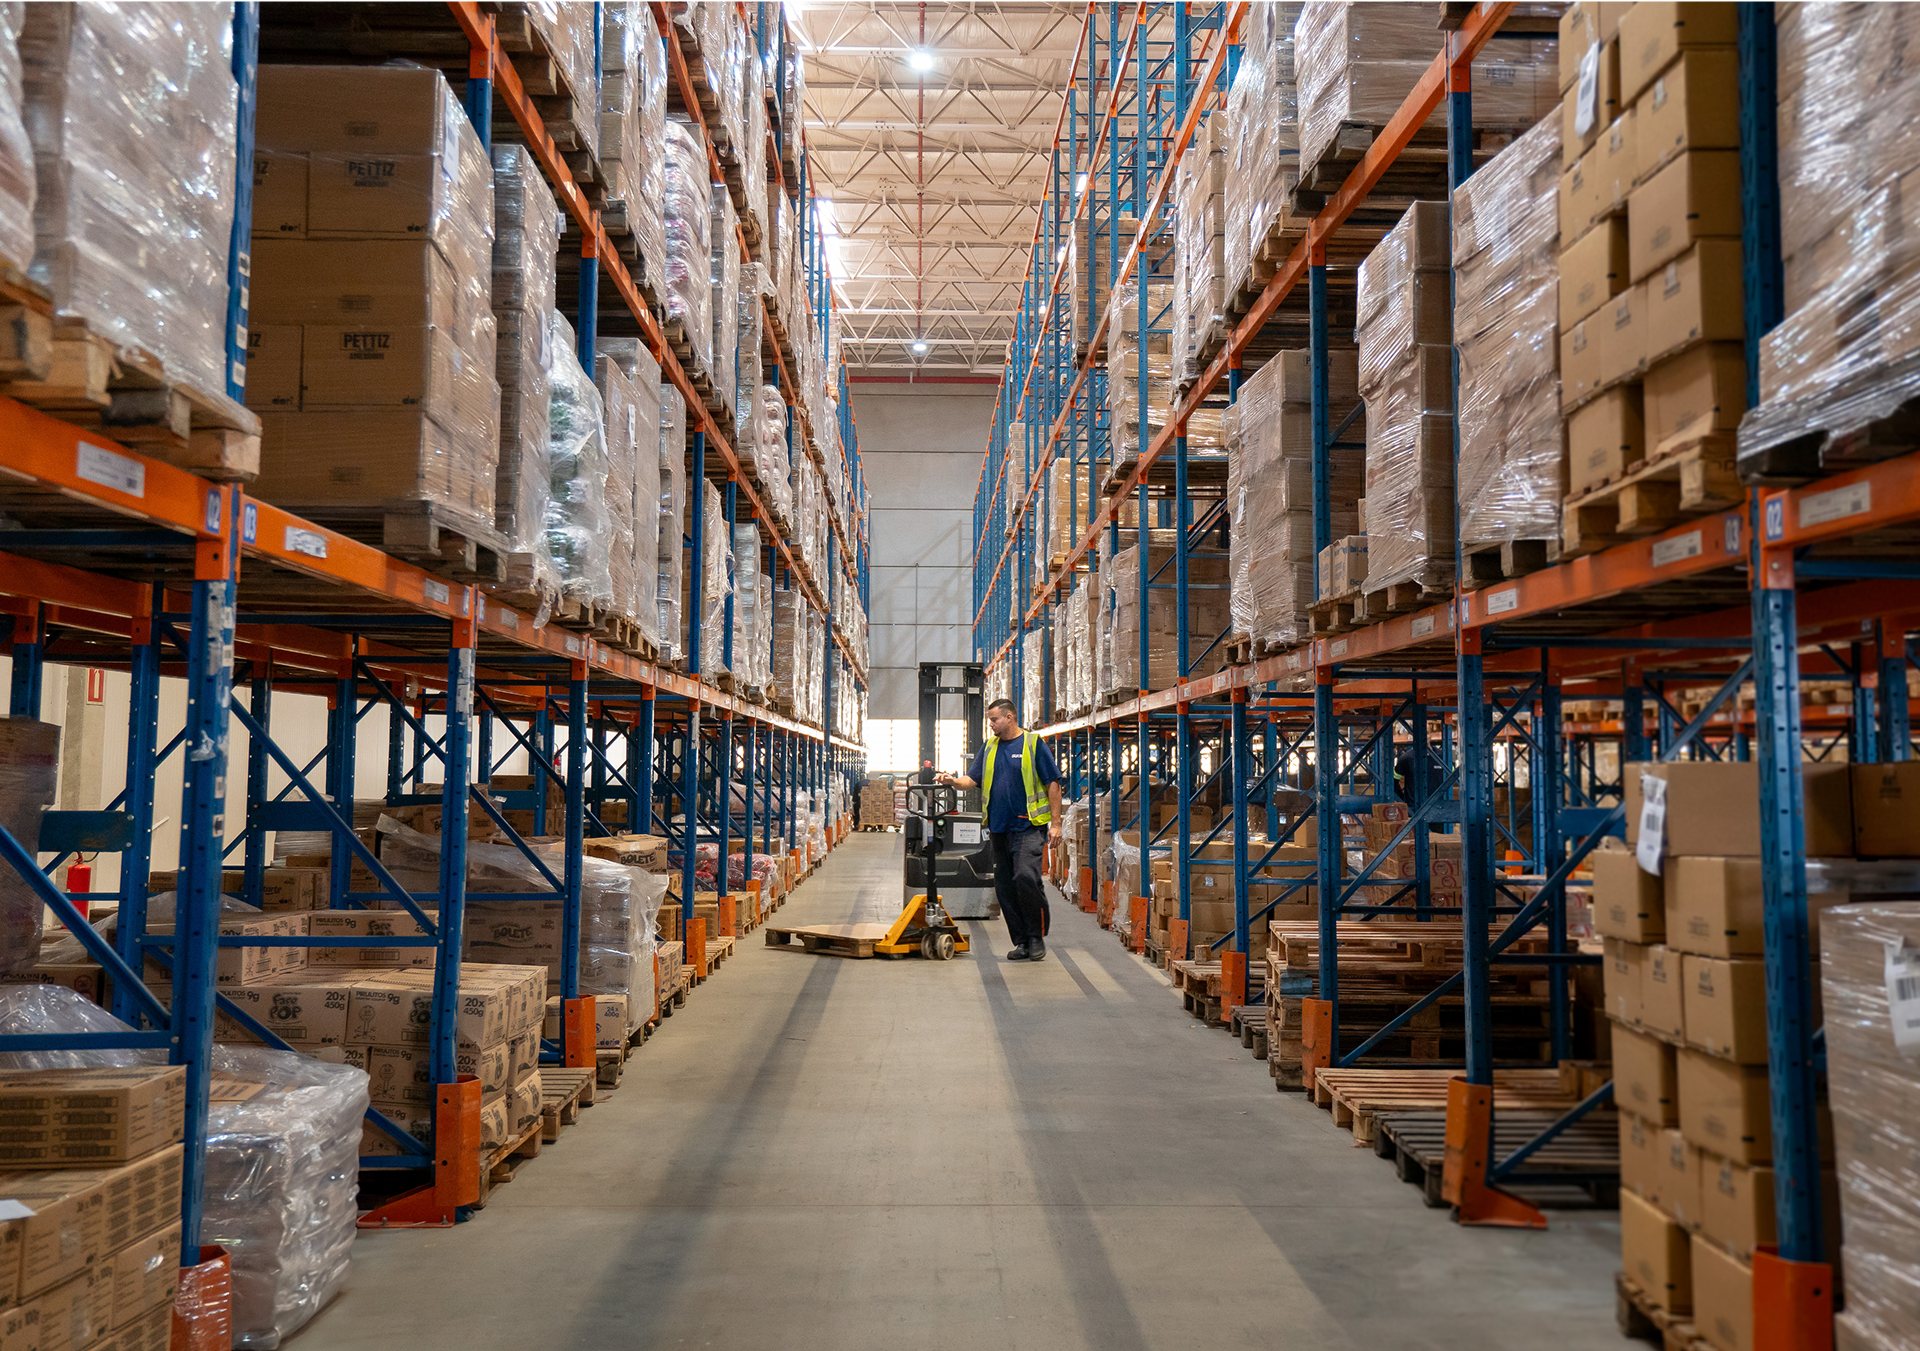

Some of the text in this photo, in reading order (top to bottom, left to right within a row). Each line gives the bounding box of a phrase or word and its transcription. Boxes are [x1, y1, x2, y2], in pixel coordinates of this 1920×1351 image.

[1485, 68, 1517, 79] PETTIZ
[348, 161, 395, 177] PETTIZ
[343, 333, 390, 348] PETTIZ
[1766, 502, 1782, 538] 02
[1726, 519, 1740, 550] 03
[620, 853, 657, 866] BOLETE
[344, 917, 357, 929] 9g
[493, 926, 533, 940] BOLETE
[246, 990, 260, 1002] 9g
[325, 991, 346, 1001] 20x
[387, 993, 400, 1005] 9g
[324, 1002, 345, 1010] 450g
[464, 997, 485, 1008] 20x
[269, 1005, 302, 1020] POP
[463, 1008, 484, 1018] 450g
[344, 1050, 365, 1060] 20x
[400, 1050, 412, 1060] 9g
[457, 1056, 477, 1066] 20x
[394, 1109, 406, 1120] 9g
